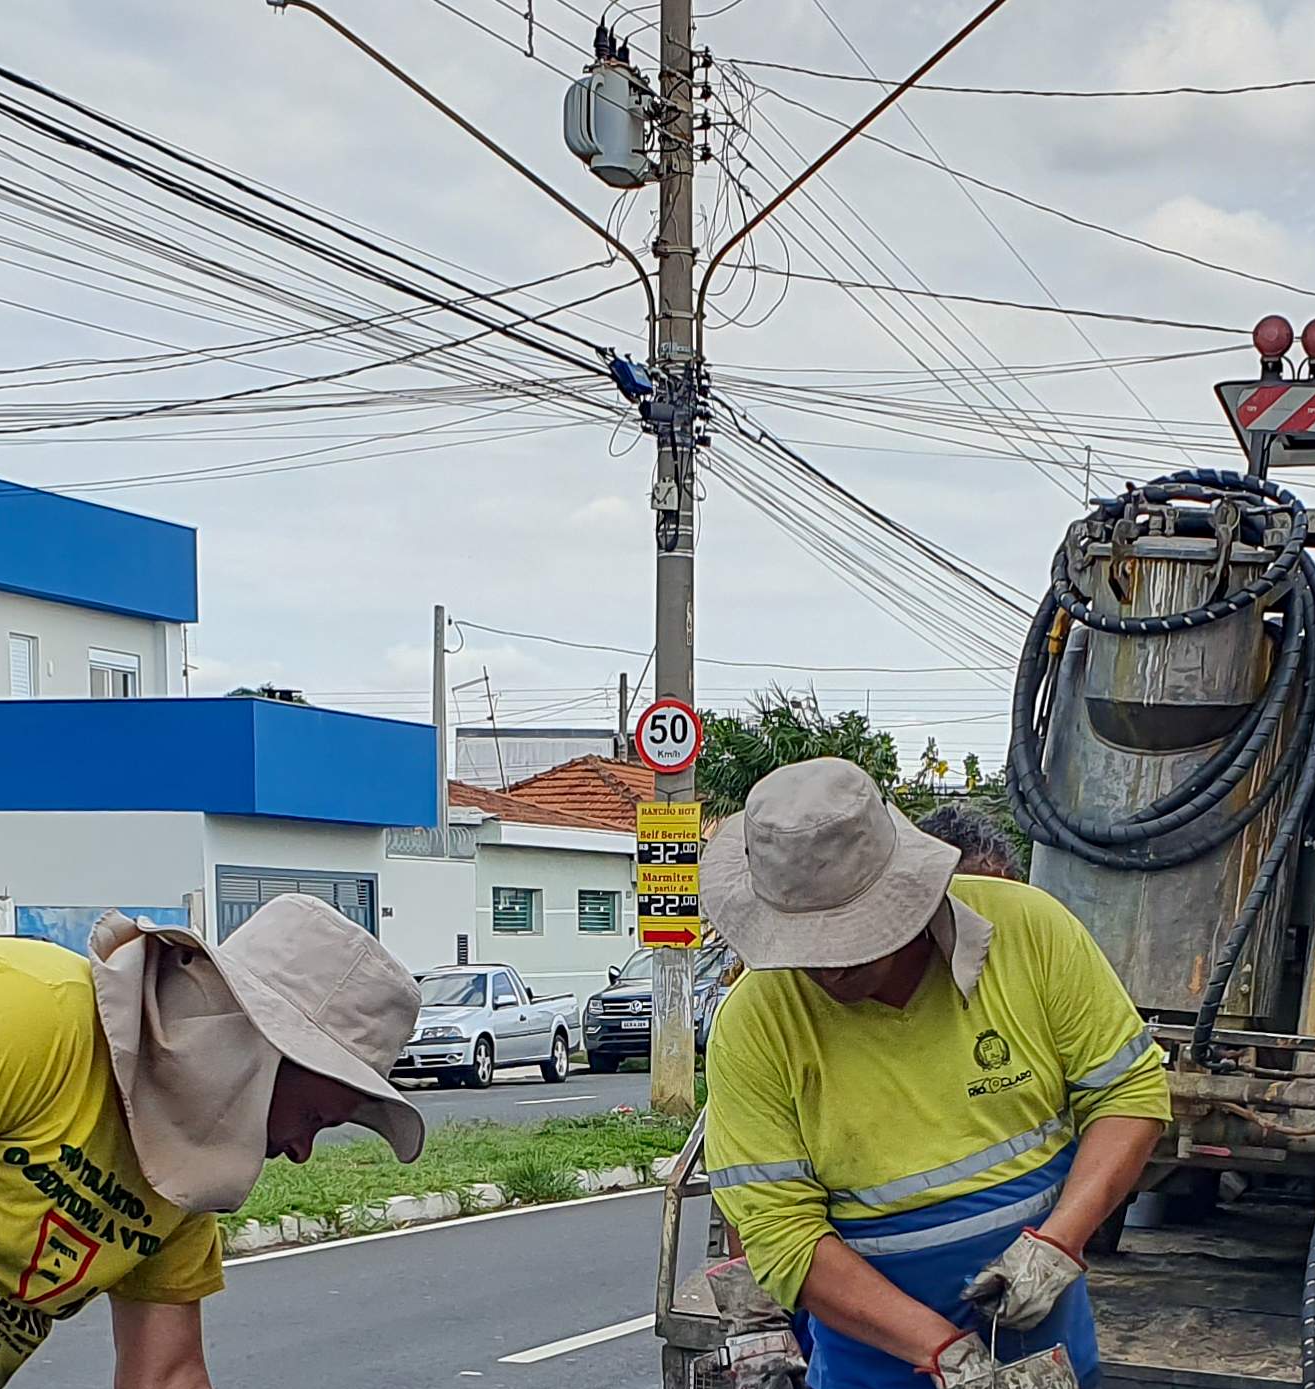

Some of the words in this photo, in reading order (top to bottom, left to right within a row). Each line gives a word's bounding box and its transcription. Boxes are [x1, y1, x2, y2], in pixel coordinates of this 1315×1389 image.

[649, 714, 688, 744] 50
[661, 829, 697, 840] Service
[642, 872, 694, 882] Marmitex
[654, 885, 677, 893] partir
